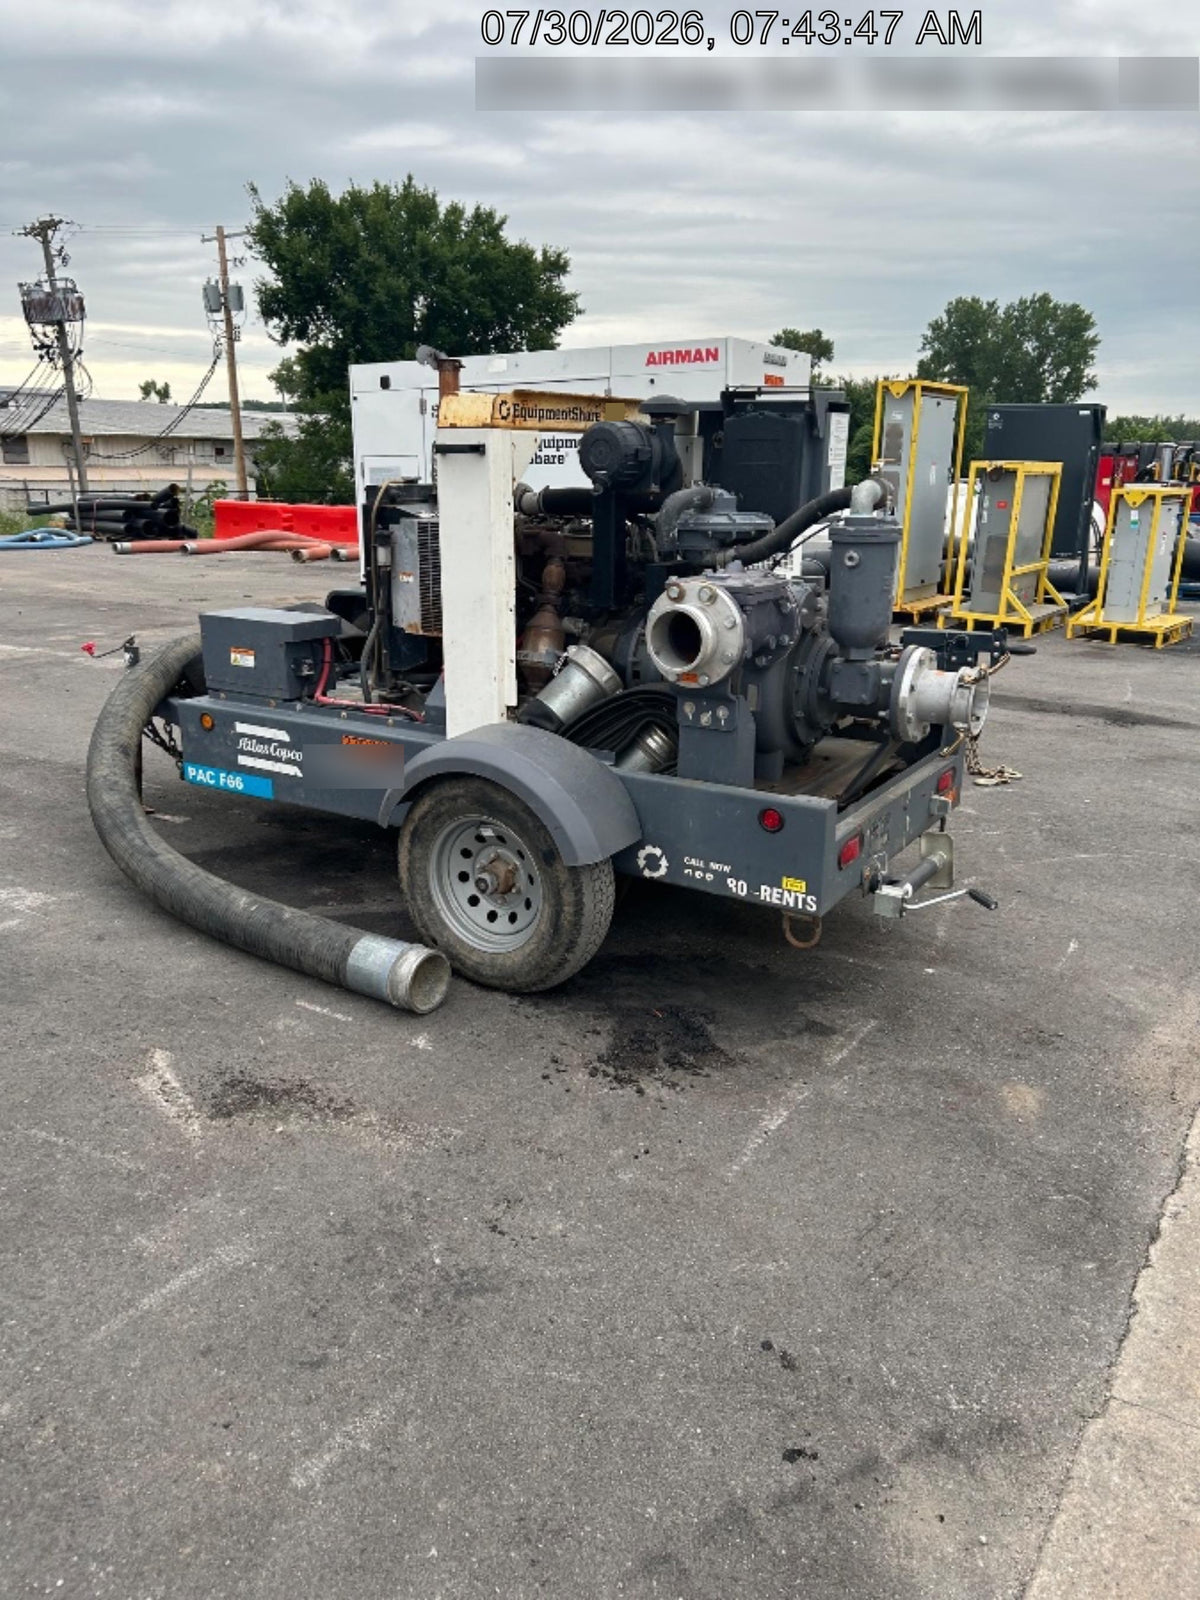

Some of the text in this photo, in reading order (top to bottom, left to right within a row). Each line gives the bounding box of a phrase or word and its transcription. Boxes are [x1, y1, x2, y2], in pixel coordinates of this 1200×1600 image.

[645, 347, 719, 367] AIRMAN
[513, 403, 601, 422] EquipmentShare
[236, 737, 303, 762] Atlas Copco
[187, 765, 244, 791] PAC F66
[683, 856, 706, 869] CALL
